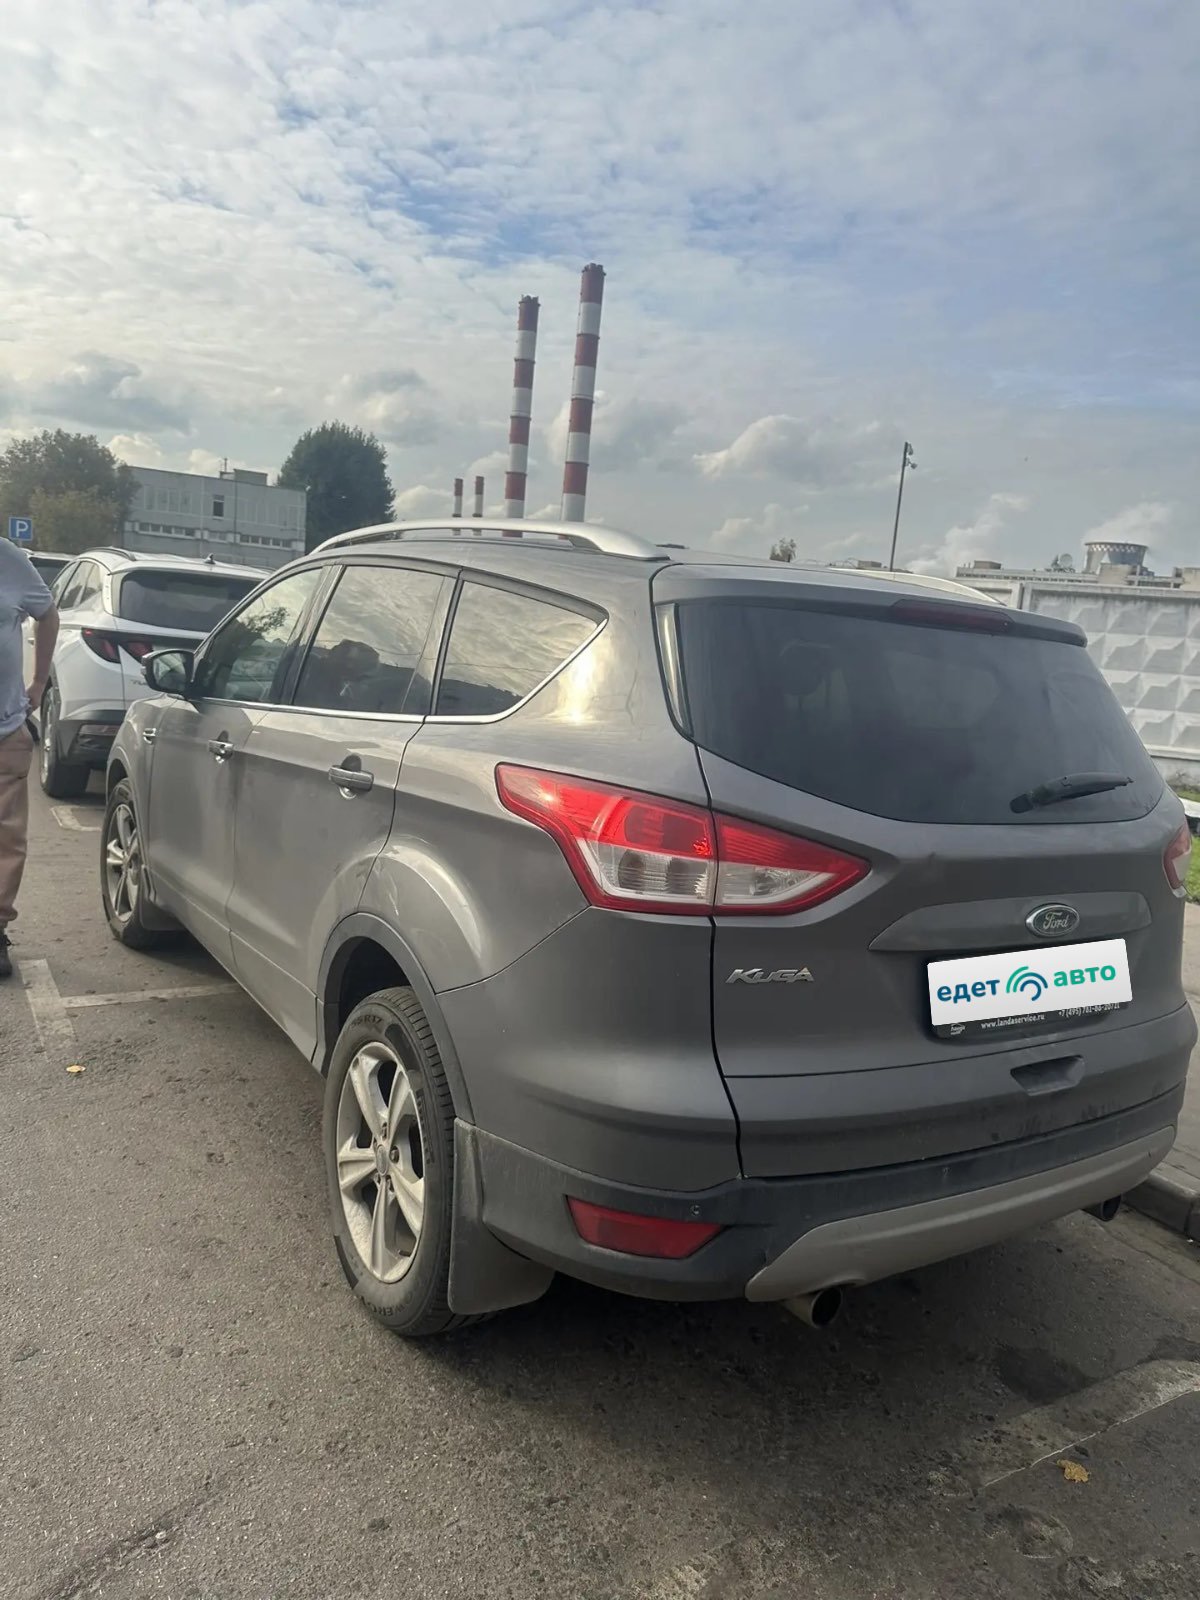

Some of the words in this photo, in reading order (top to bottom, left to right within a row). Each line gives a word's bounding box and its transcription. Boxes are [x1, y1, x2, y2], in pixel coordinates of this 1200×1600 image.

[16, 520, 29, 537] P
[1043, 911, 1069, 930] Ford
[981, 1013, 1045, 1029] www.landaservice.ru
